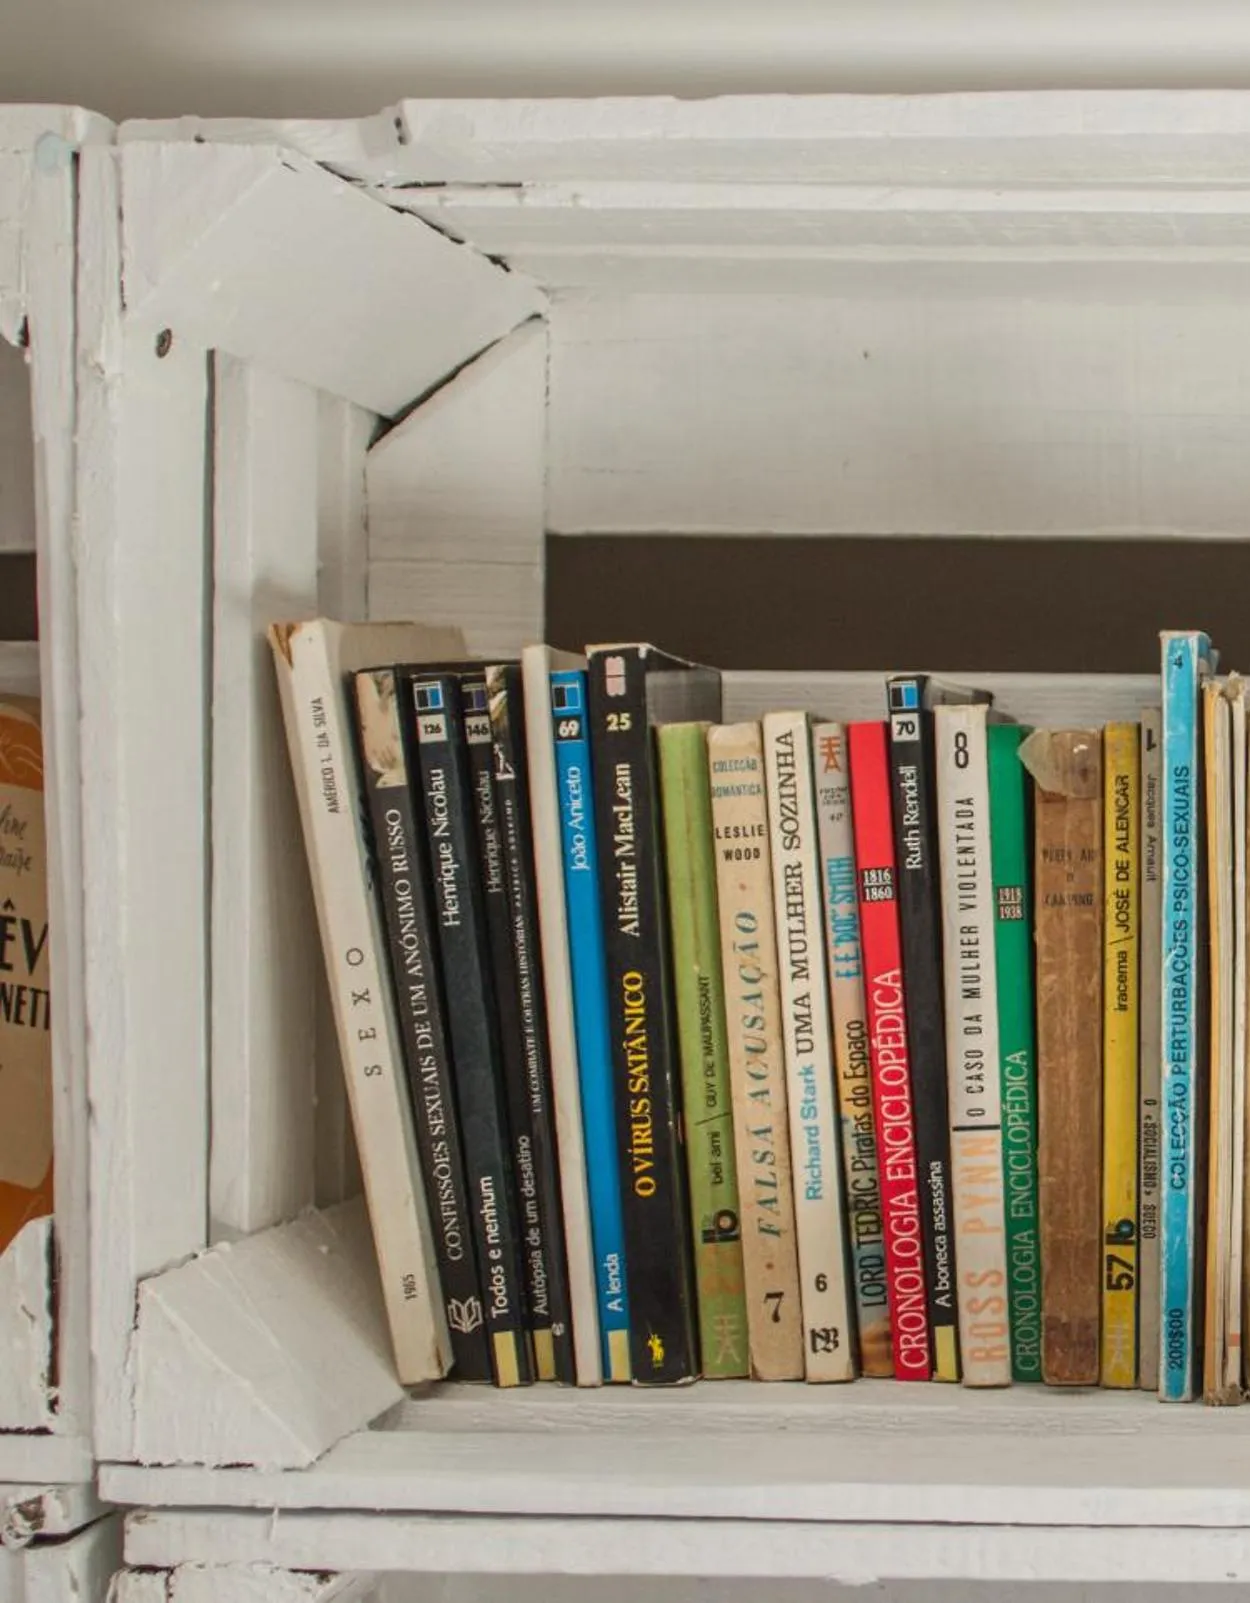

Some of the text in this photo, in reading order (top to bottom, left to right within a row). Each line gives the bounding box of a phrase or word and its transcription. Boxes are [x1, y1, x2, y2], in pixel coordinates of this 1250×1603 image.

[310, 697, 326, 728] SILVA
[423, 723, 443, 735] 126
[464, 719, 491, 739] 146
[558, 721, 581, 738] 69
[606, 712, 632, 732] 25
[895, 721, 916, 736] 70
[953, 731, 970, 770] 8
[322, 767, 340, 814] AMÉRICO
[564, 765, 590, 872] João Aniceto
[898, 764, 923, 870] Ruth Rendell
[1145, 772, 1158, 830] Jacques
[427, 768, 462, 927] Henrique Nicolau
[476, 769, 504, 893] Henrique Nicolau
[612, 762, 641, 938] Alistair MacLean
[714, 824, 767, 840] LESLIE
[723, 847, 760, 862] WOOD
[1112, 774, 1131, 934] JOSÉ DE ALENCAR
[774, 729, 815, 1056] UMA MULHER SOZINHA
[826, 856, 854, 905] SMITH
[863, 868, 892, 886] 1816
[954, 796, 986, 1118] O CASO DA MULHER VIOLENTADA
[1113, 950, 1129, 1013] iracema
[1166, 765, 1192, 1191] COLECÇÃO PERTURBAÇÕES PSICO-SEXUAIS
[519, 977, 535, 1024] OUTRAS
[385, 808, 464, 1261] CONFISSÕES SEXUAIS DE UM ANÓNIMO RUSSO
[526, 1036, 542, 1092] COMBATE
[697, 975, 718, 1108] GUY DE MAUPASSANT
[621, 970, 657, 1197] O VÍRUS SATÂNICO
[732, 911, 783, 1241] FALSA ACUSAÇÃO
[707, 1130, 724, 1186] bel ami
[797, 1064, 824, 1200] Richard Stark
[843, 1019, 887, 1308] LORD TEDRIC Piratas do Espaço
[872, 967, 929, 1369] CRONOLOGIA ENCICLOPÉDICA
[516, 1134, 551, 1316] Autópsia de um desatino
[927, 1160, 953, 1308] A boneca assassina
[1001, 1048, 1041, 1372] CRONOLOGIA ENCICLOPÉDICA
[1143, 1204, 1158, 1240] SUECO
[478, 1176, 509, 1319] Todos e nenhum
[957, 1134, 1008, 1363] ROSS PYNN
[1105, 1253, 1134, 1292] 57
[402, 1274, 418, 1301] 1965
[603, 1253, 622, 1313] A lenda
[763, 1290, 785, 1324] 7
[814, 1273, 828, 1293] 6
[1166, 1307, 1185, 1371] 200$00
